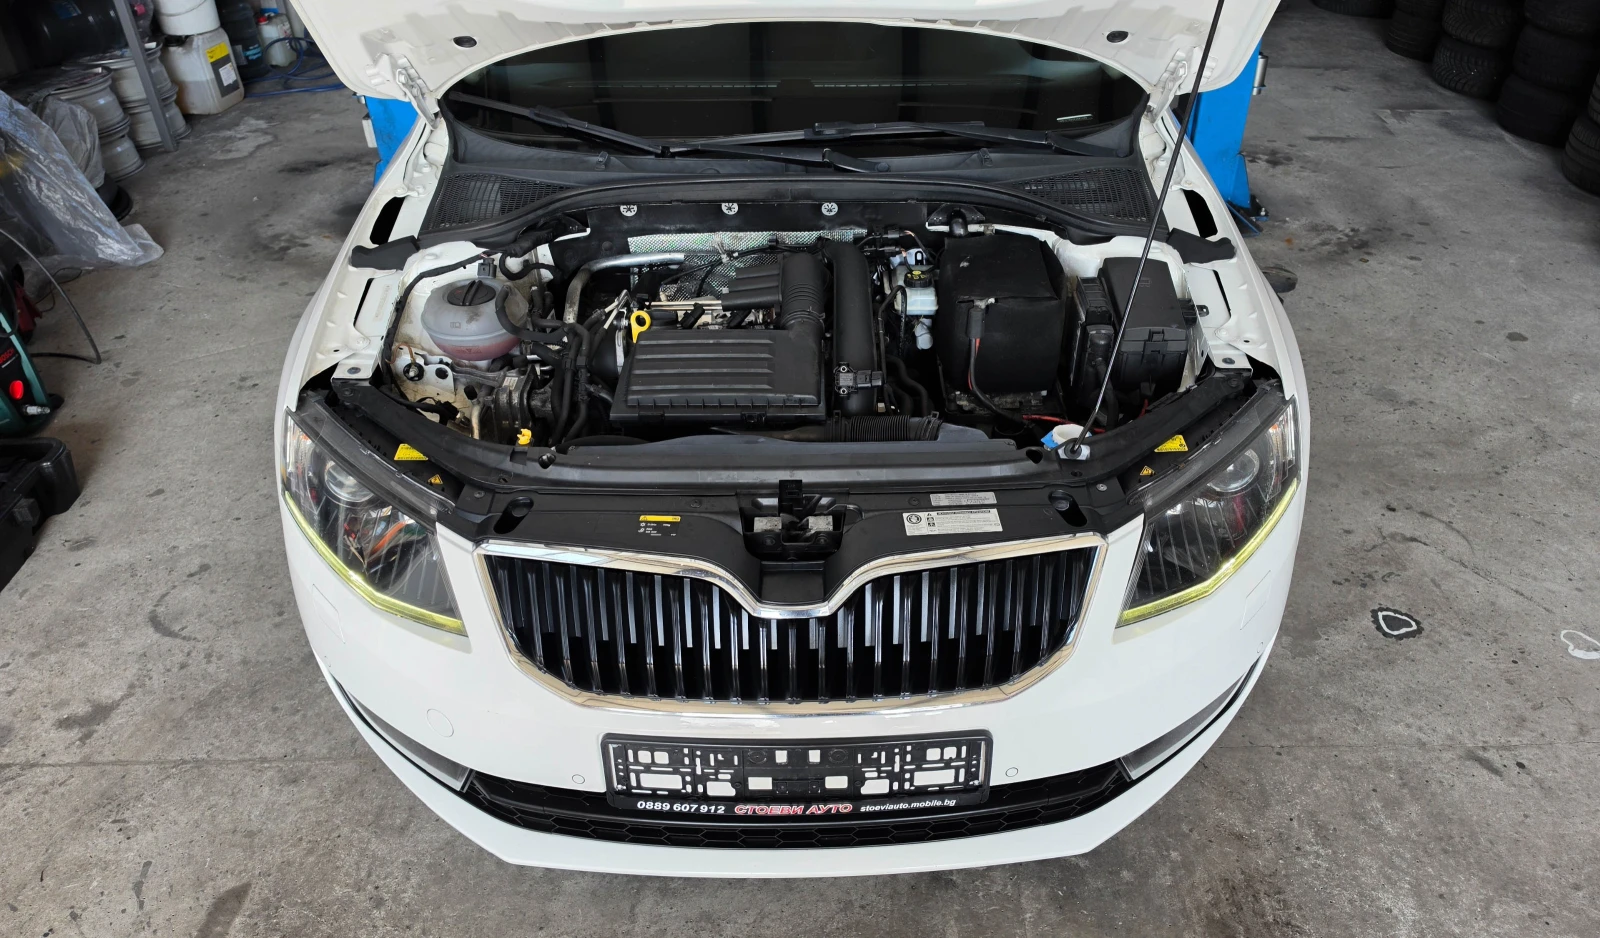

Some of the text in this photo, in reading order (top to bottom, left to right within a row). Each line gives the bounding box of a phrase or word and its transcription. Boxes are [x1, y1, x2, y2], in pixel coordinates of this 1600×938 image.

[637, 801, 725, 814] 0889 607 912
[734, 803, 853, 815] СТОЕВИ АУТО
[860, 799, 956, 812] stoeviauto.mobile.bg
